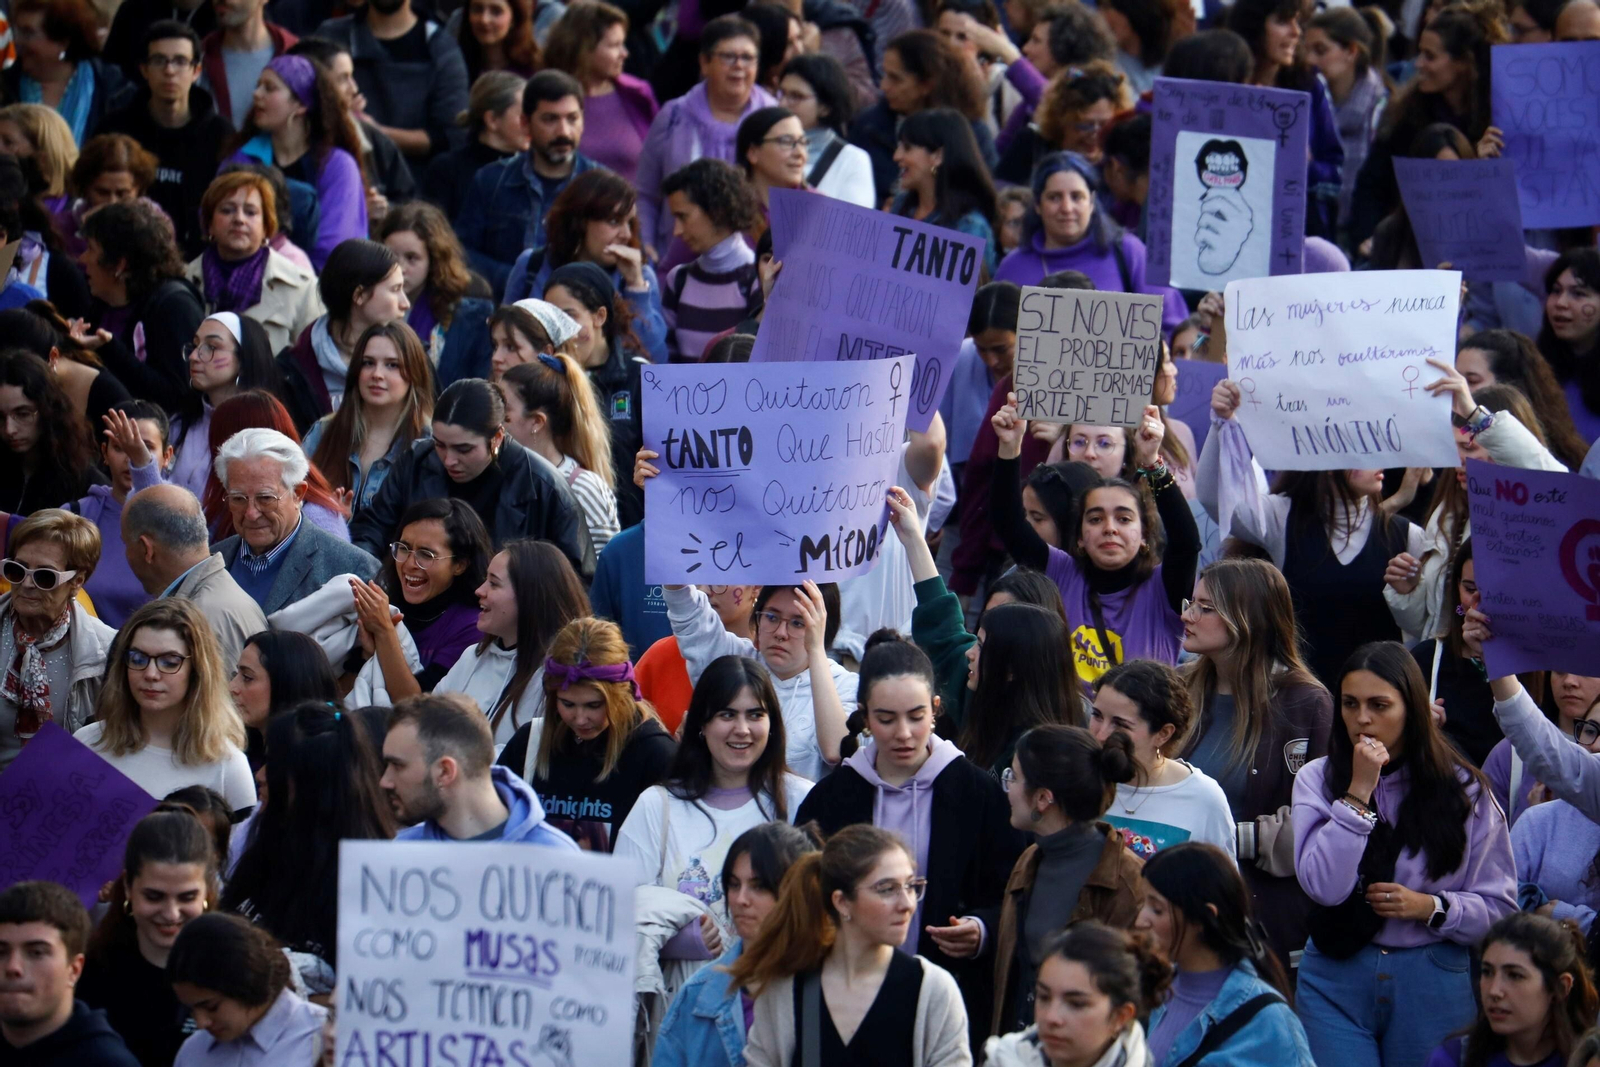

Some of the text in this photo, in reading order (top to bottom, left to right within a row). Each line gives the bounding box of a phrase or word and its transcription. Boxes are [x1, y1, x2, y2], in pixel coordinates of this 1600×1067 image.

[891, 225, 977, 286] TANTO
[802, 263, 836, 311] NOS
[845, 273, 940, 339] QUITARON
[1020, 293, 1158, 341] SI NO VES
[1236, 290, 1447, 332] Las mujeres nunca
[1018, 336, 1156, 371] EL PROBLEMA
[1234, 344, 1443, 372] más nos ocultaremos
[666, 376, 874, 415] nos Quitaron
[1015, 365, 1153, 396] ES QUE FORMAS
[1016, 390, 1070, 418] PARTE
[1075, 395, 1099, 423] DE
[1275, 392, 1308, 413] tras
[776, 422, 834, 464] Que
[846, 413, 896, 459] Hasta
[669, 484, 737, 515] nos
[1469, 477, 1568, 506] Que NO esté
[711, 532, 752, 572] el
[540, 793, 613, 819] idnights
[360, 864, 462, 922] NOS
[353, 927, 438, 962] COMO
[344, 975, 409, 1023] NOS
[549, 996, 607, 1027] COMO
